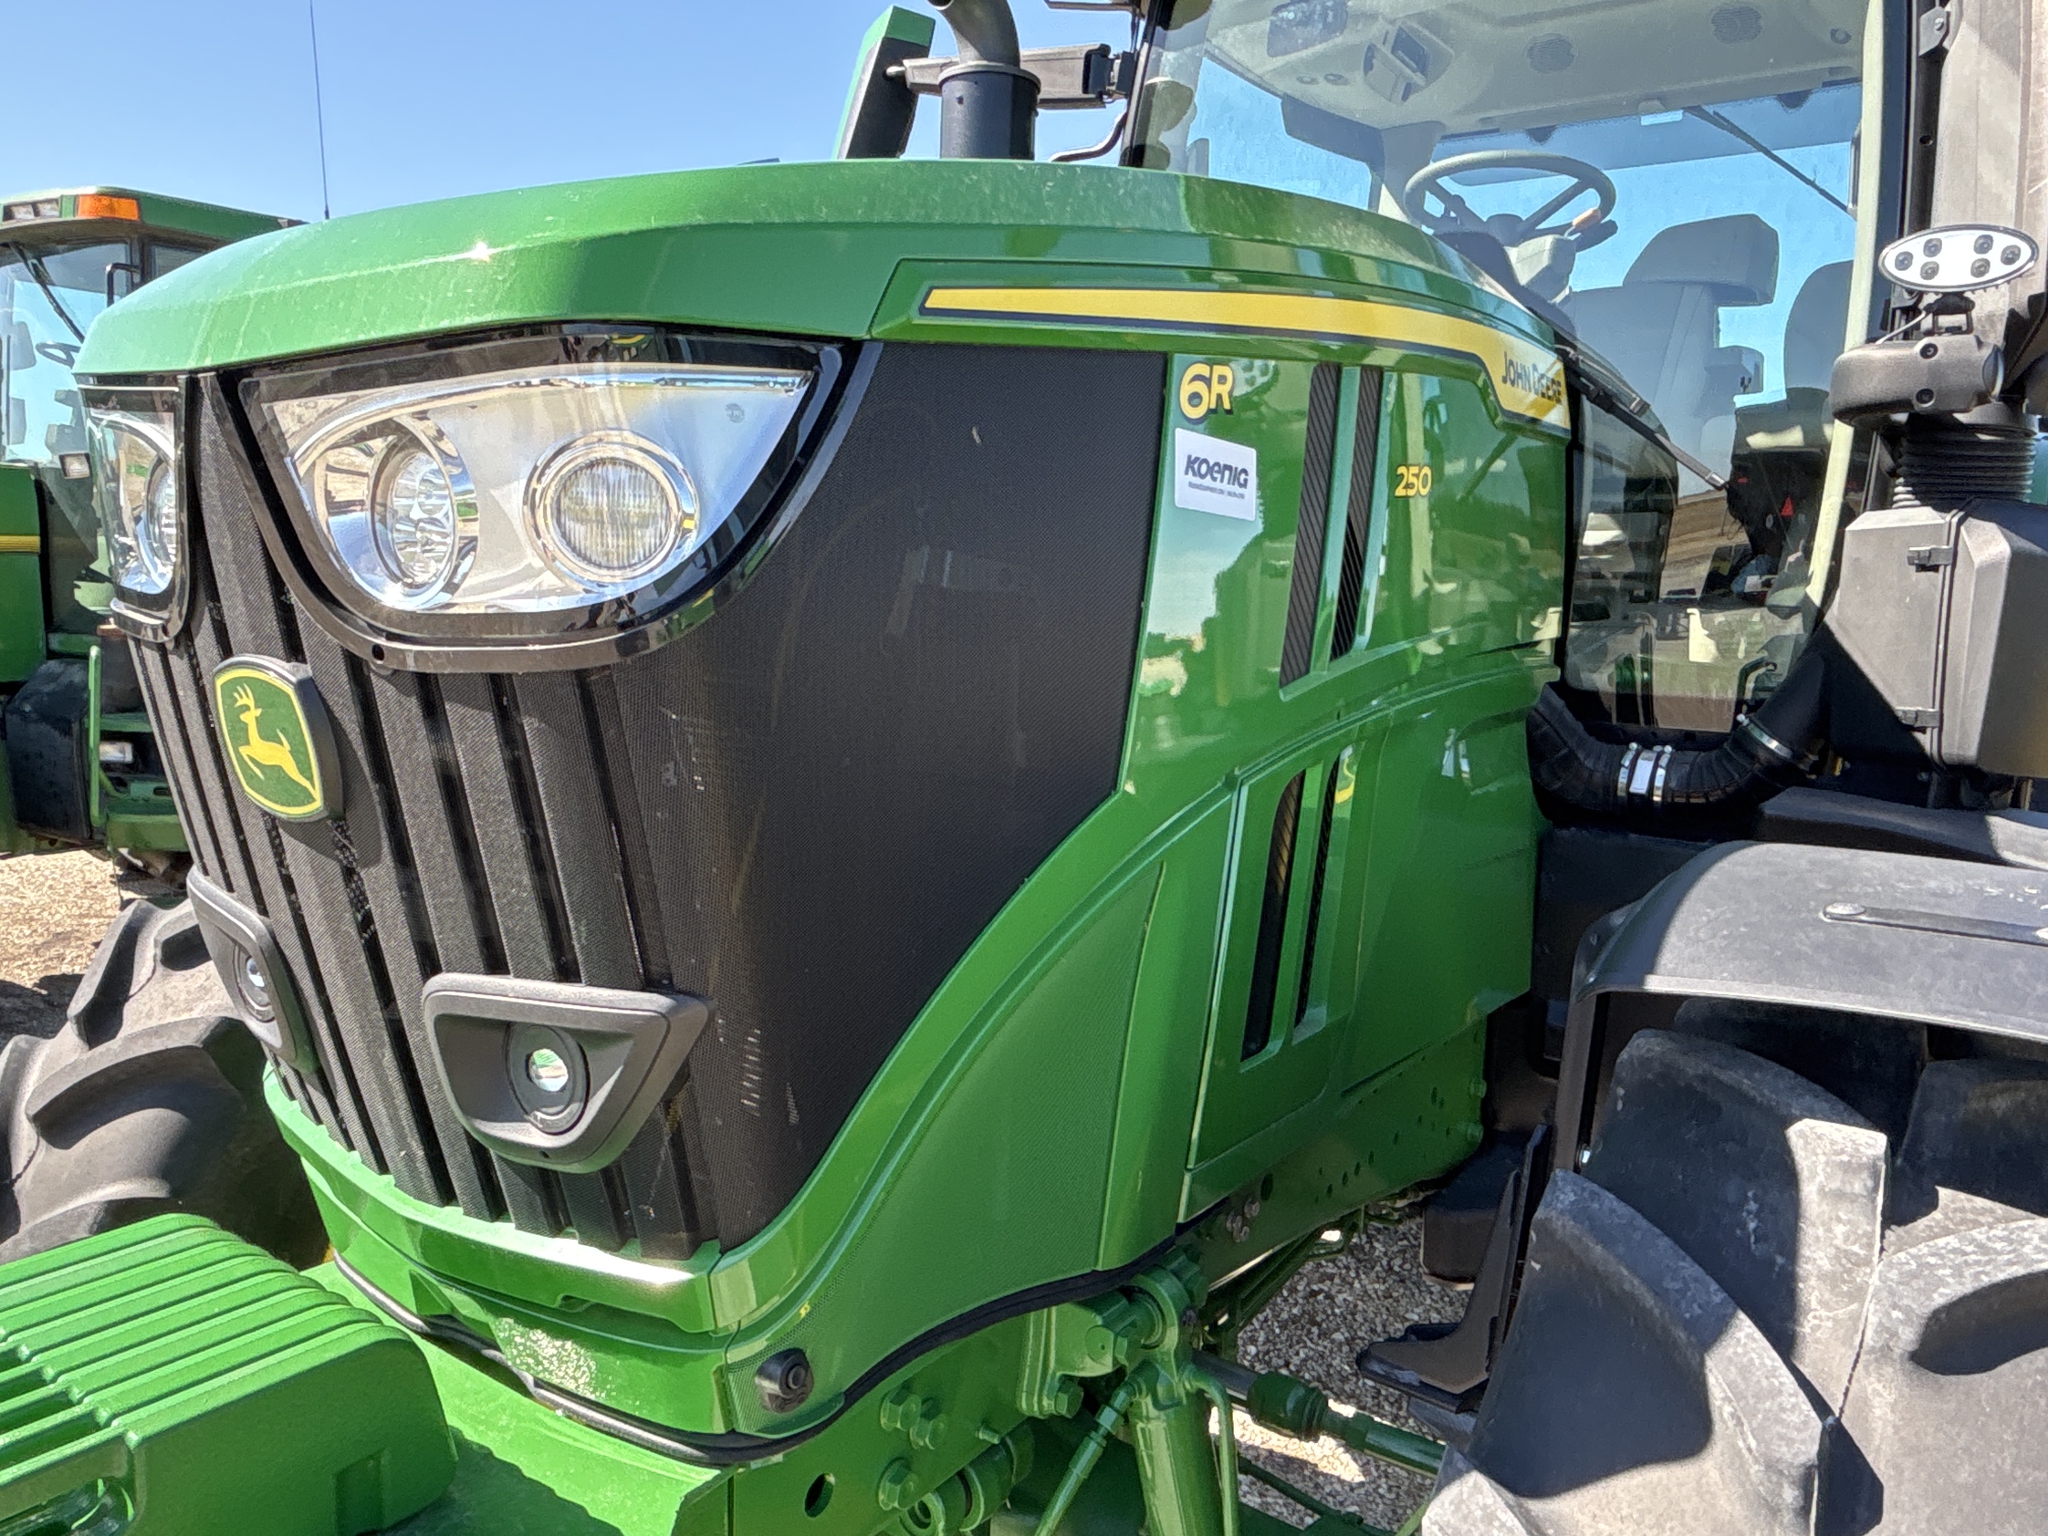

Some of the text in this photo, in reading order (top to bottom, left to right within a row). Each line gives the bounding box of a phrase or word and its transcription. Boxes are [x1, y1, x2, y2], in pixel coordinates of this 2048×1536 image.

[1179, 363, 1234, 425] 6R
[1502, 351, 1562, 405] JOHN DEERE
[1394, 465, 1432, 497] 250
